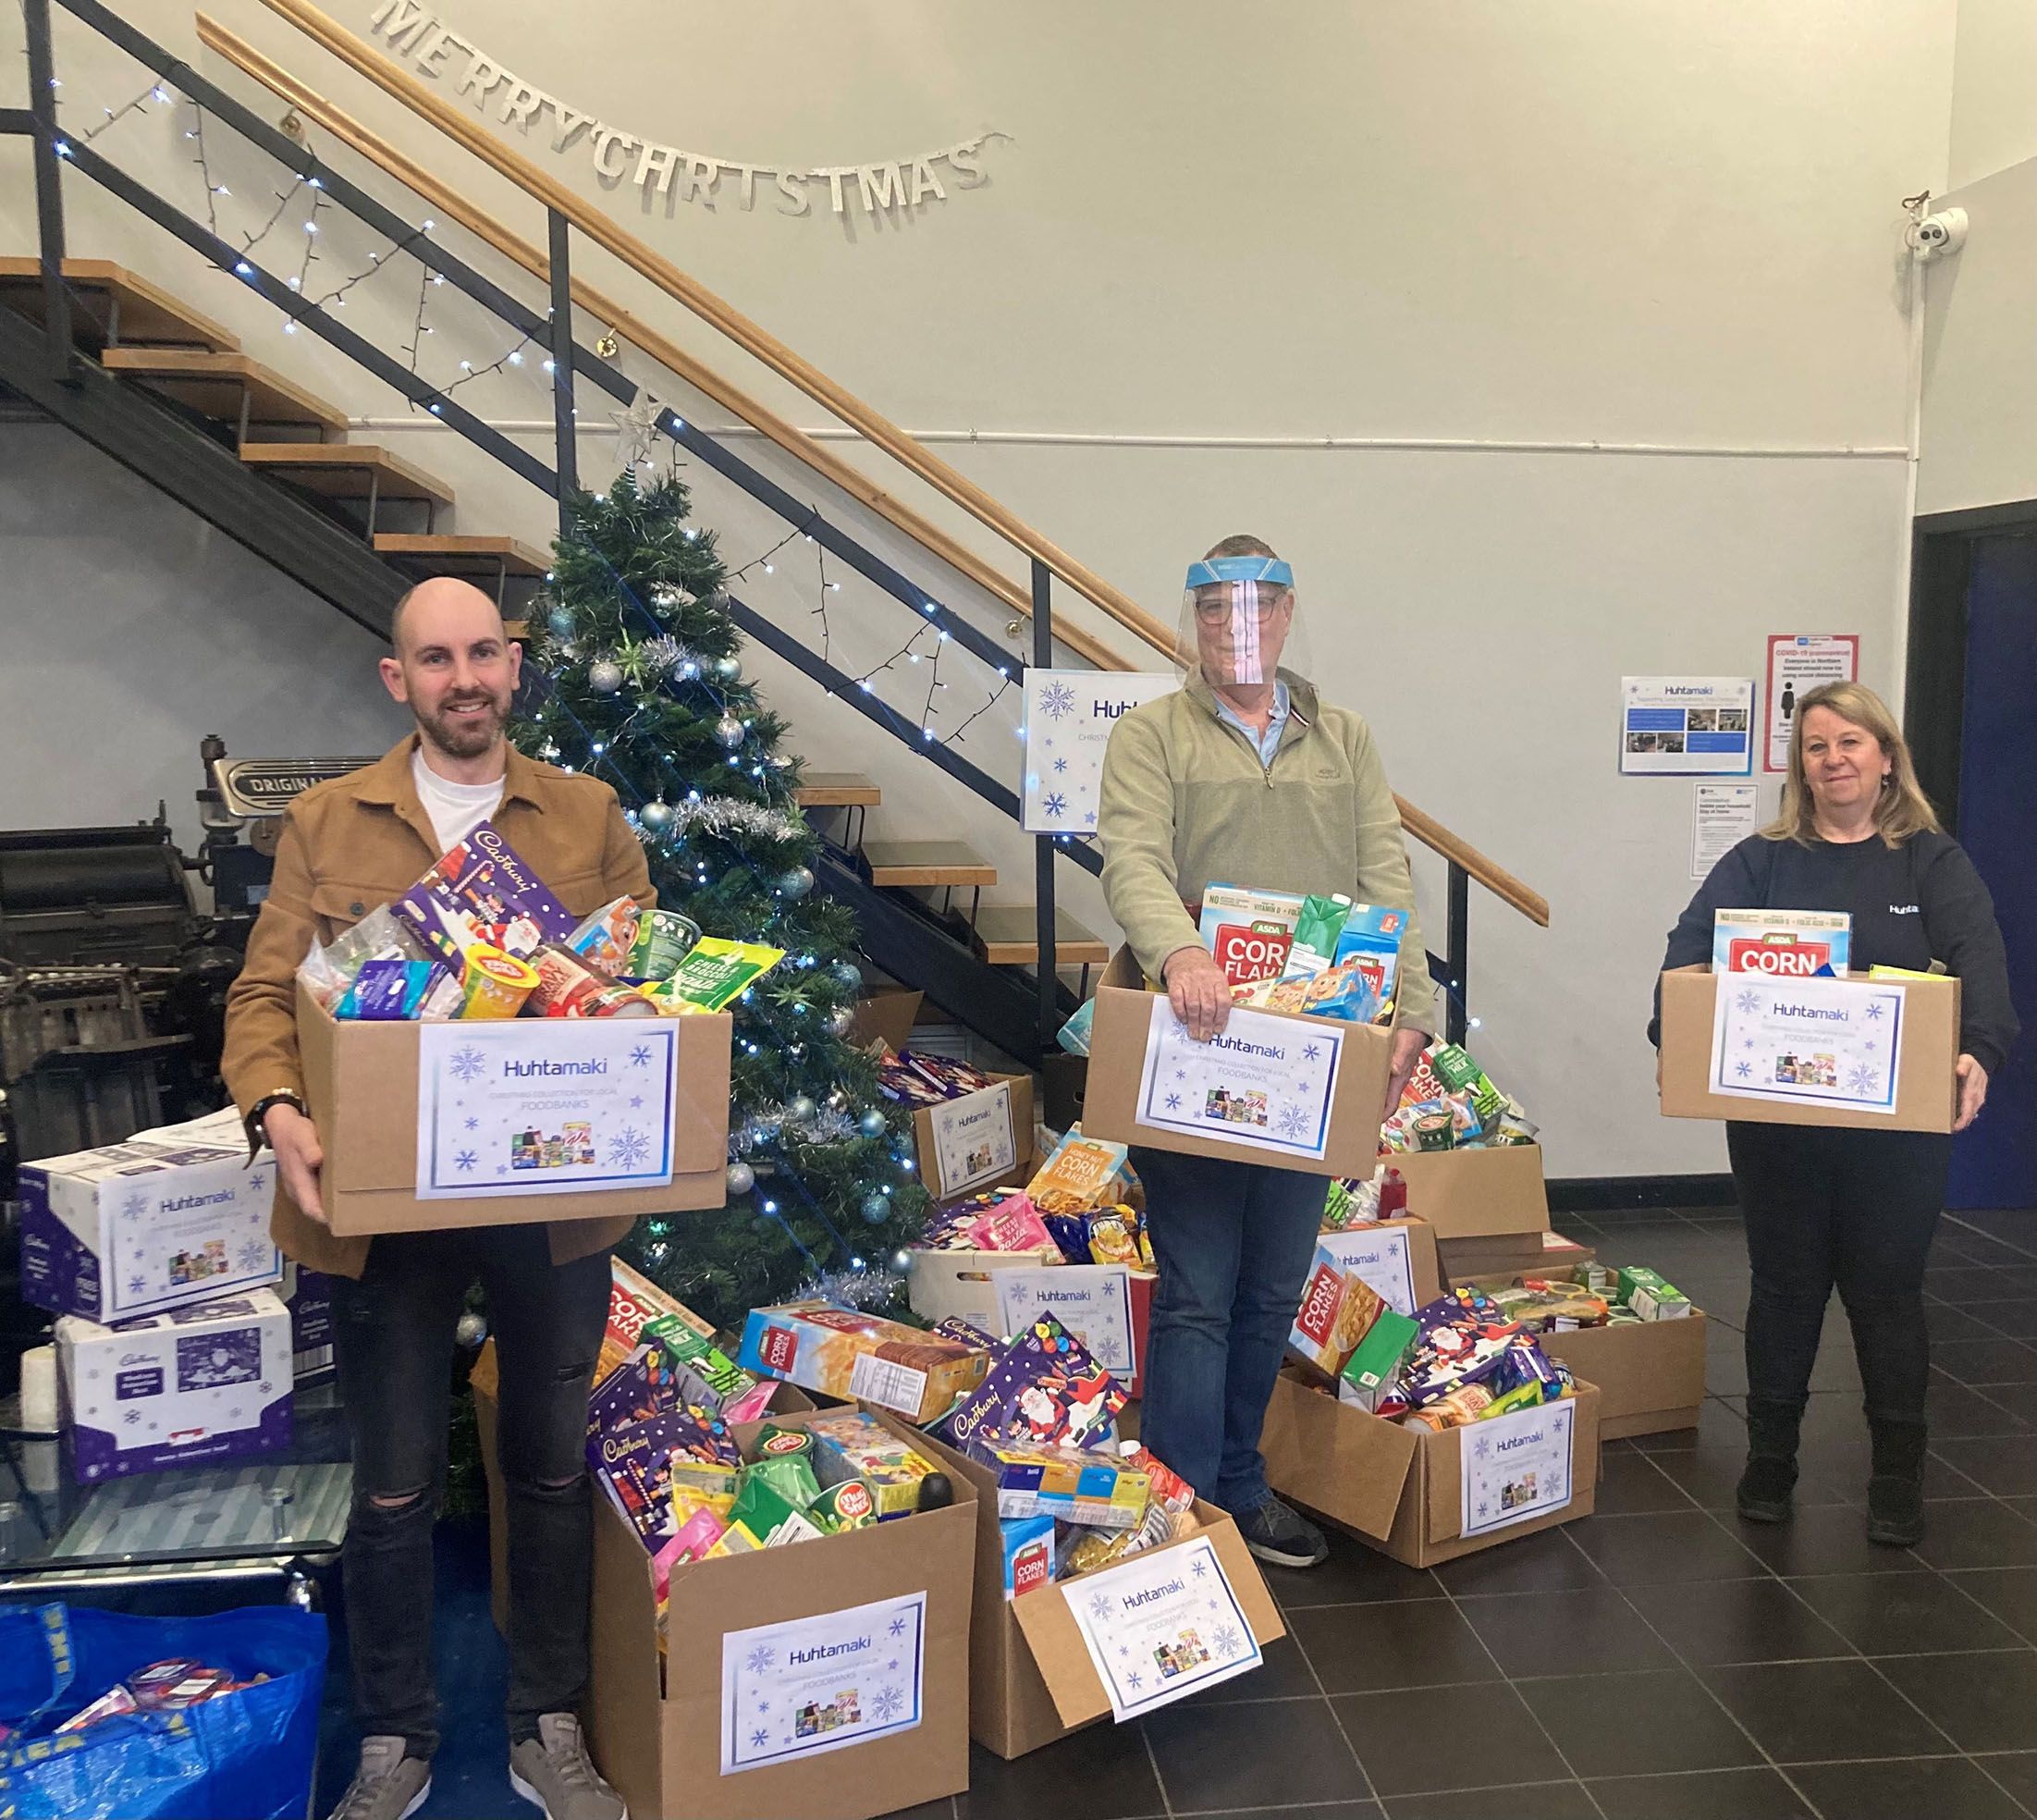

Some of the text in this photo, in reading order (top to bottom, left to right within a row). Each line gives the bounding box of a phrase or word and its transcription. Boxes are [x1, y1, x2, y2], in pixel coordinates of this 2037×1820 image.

[372, 0, 988, 216] MERRY CHRISTMAS
[1664, 686, 1713, 695] Huhtamaki
[249, 777, 324, 792] ORIGINA
[474, 830, 531, 893] Cadbury
[1257, 924, 1281, 935] ASDA
[1226, 937, 1289, 967] COR
[1740, 950, 1817, 974] CORN
[1224, 961, 1282, 980] FLAK
[1773, 1002, 1849, 1022] Huhtamaki
[1209, 1033, 1286, 1060] Huhtamaki
[504, 1057, 607, 1077] Huhtamaki
[1217, 1066, 1268, 1083] FOODBANKS
[521, 1099, 590, 1111] FOODBANKS
[957, 1110, 991, 1128] Huhtamaki
[1052, 1166, 1091, 1187] FLAKES
[1061, 1155, 1100, 1178] CORN
[160, 1187, 236, 1213] Huhtamaki
[1337, 1250, 1380, 1267] htamaki
[1037, 1289, 1091, 1302] Huhtamaki
[1304, 1272, 1332, 1329] CORN
[1312, 1282, 1339, 1335] FLAKES
[944, 1319, 992, 1350] Cadbury
[770, 1332, 785, 1364] CORN
[778, 1335, 791, 1367] FLAKES
[954, 1390, 1002, 1440] Cadbury
[602, 1436, 651, 1463] Cadbury
[1496, 1429, 1544, 1453] Huhtamaki
[840, 1488, 866, 1505] Mug
[844, 1498, 872, 1515] Shot
[1017, 1559, 1045, 1578] CORN
[1017, 1570, 1045, 1585] FLAKES
[1122, 1576, 1185, 1610] Huhtamaki
[789, 1635, 872, 1665] Huhtamaki
